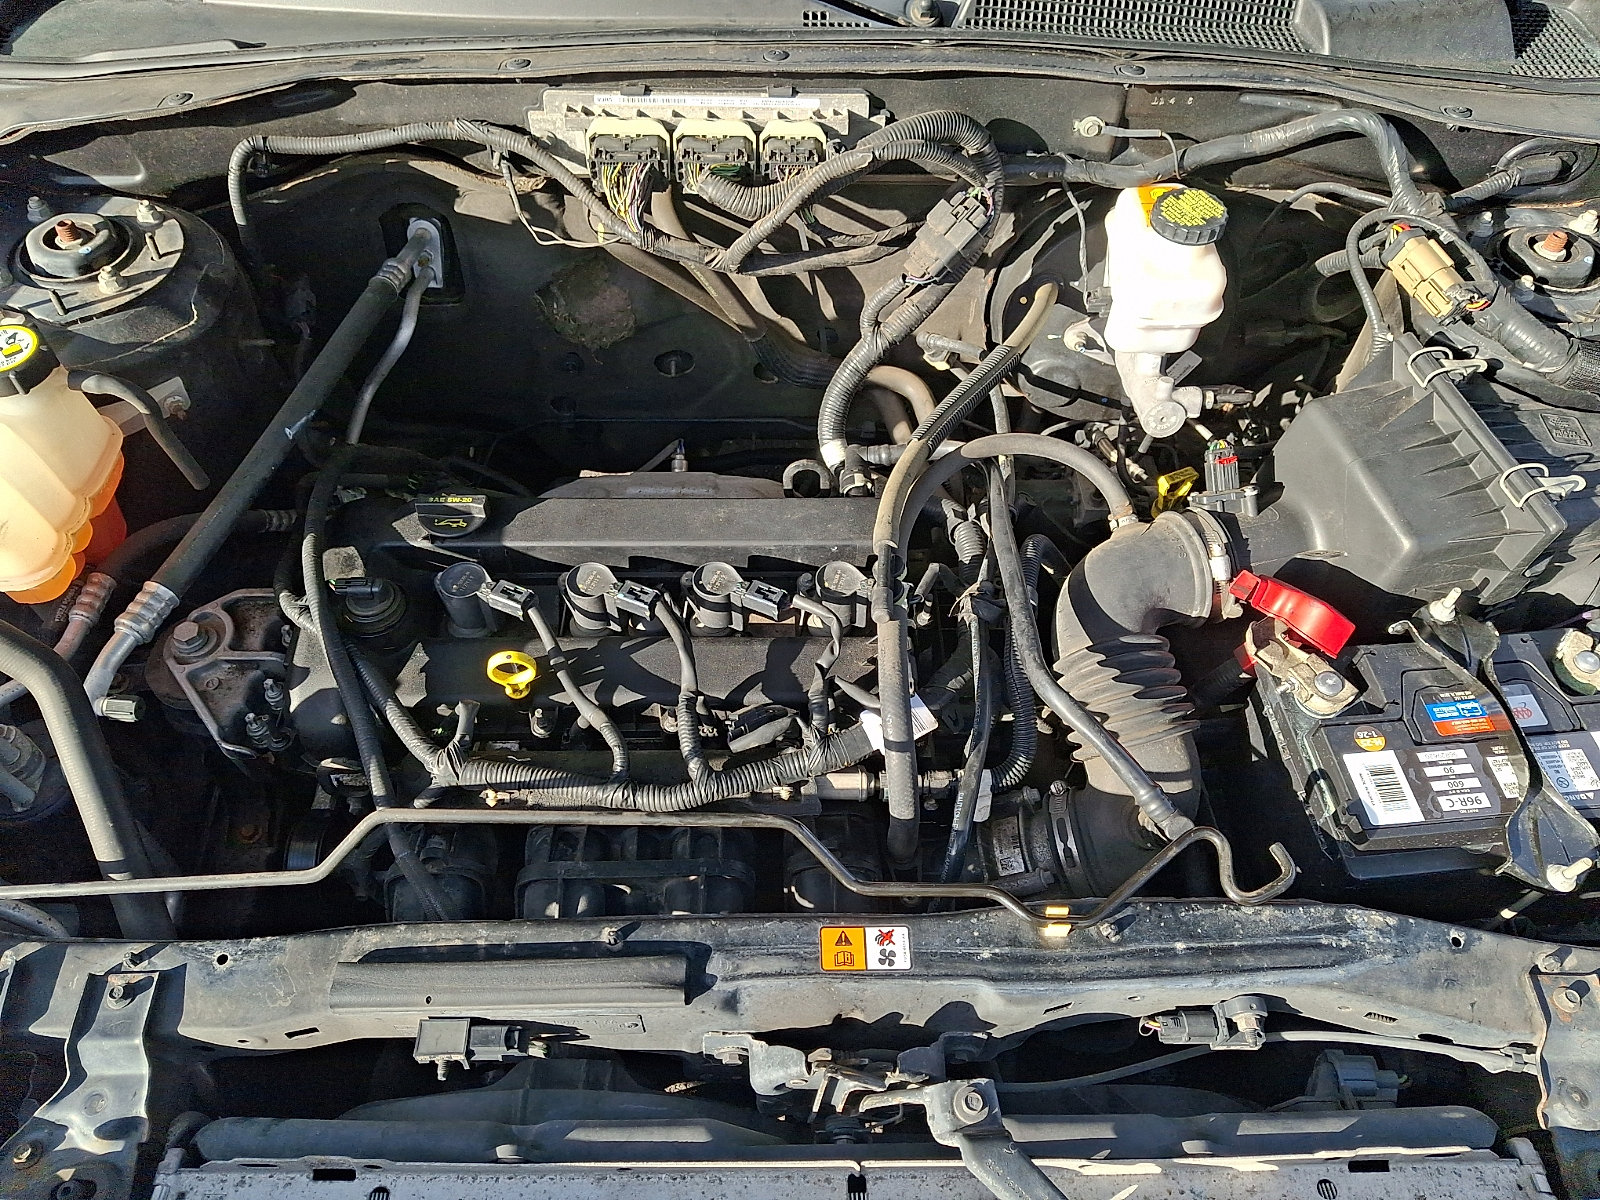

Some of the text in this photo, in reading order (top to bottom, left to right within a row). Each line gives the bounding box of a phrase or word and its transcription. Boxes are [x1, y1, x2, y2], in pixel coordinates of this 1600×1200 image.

[1357, 730, 1378, 739] 1-26
[1443, 766, 1455, 774] 90
[1447, 780, 1465, 788] 600
[1445, 795, 1483, 808] 96R-C
